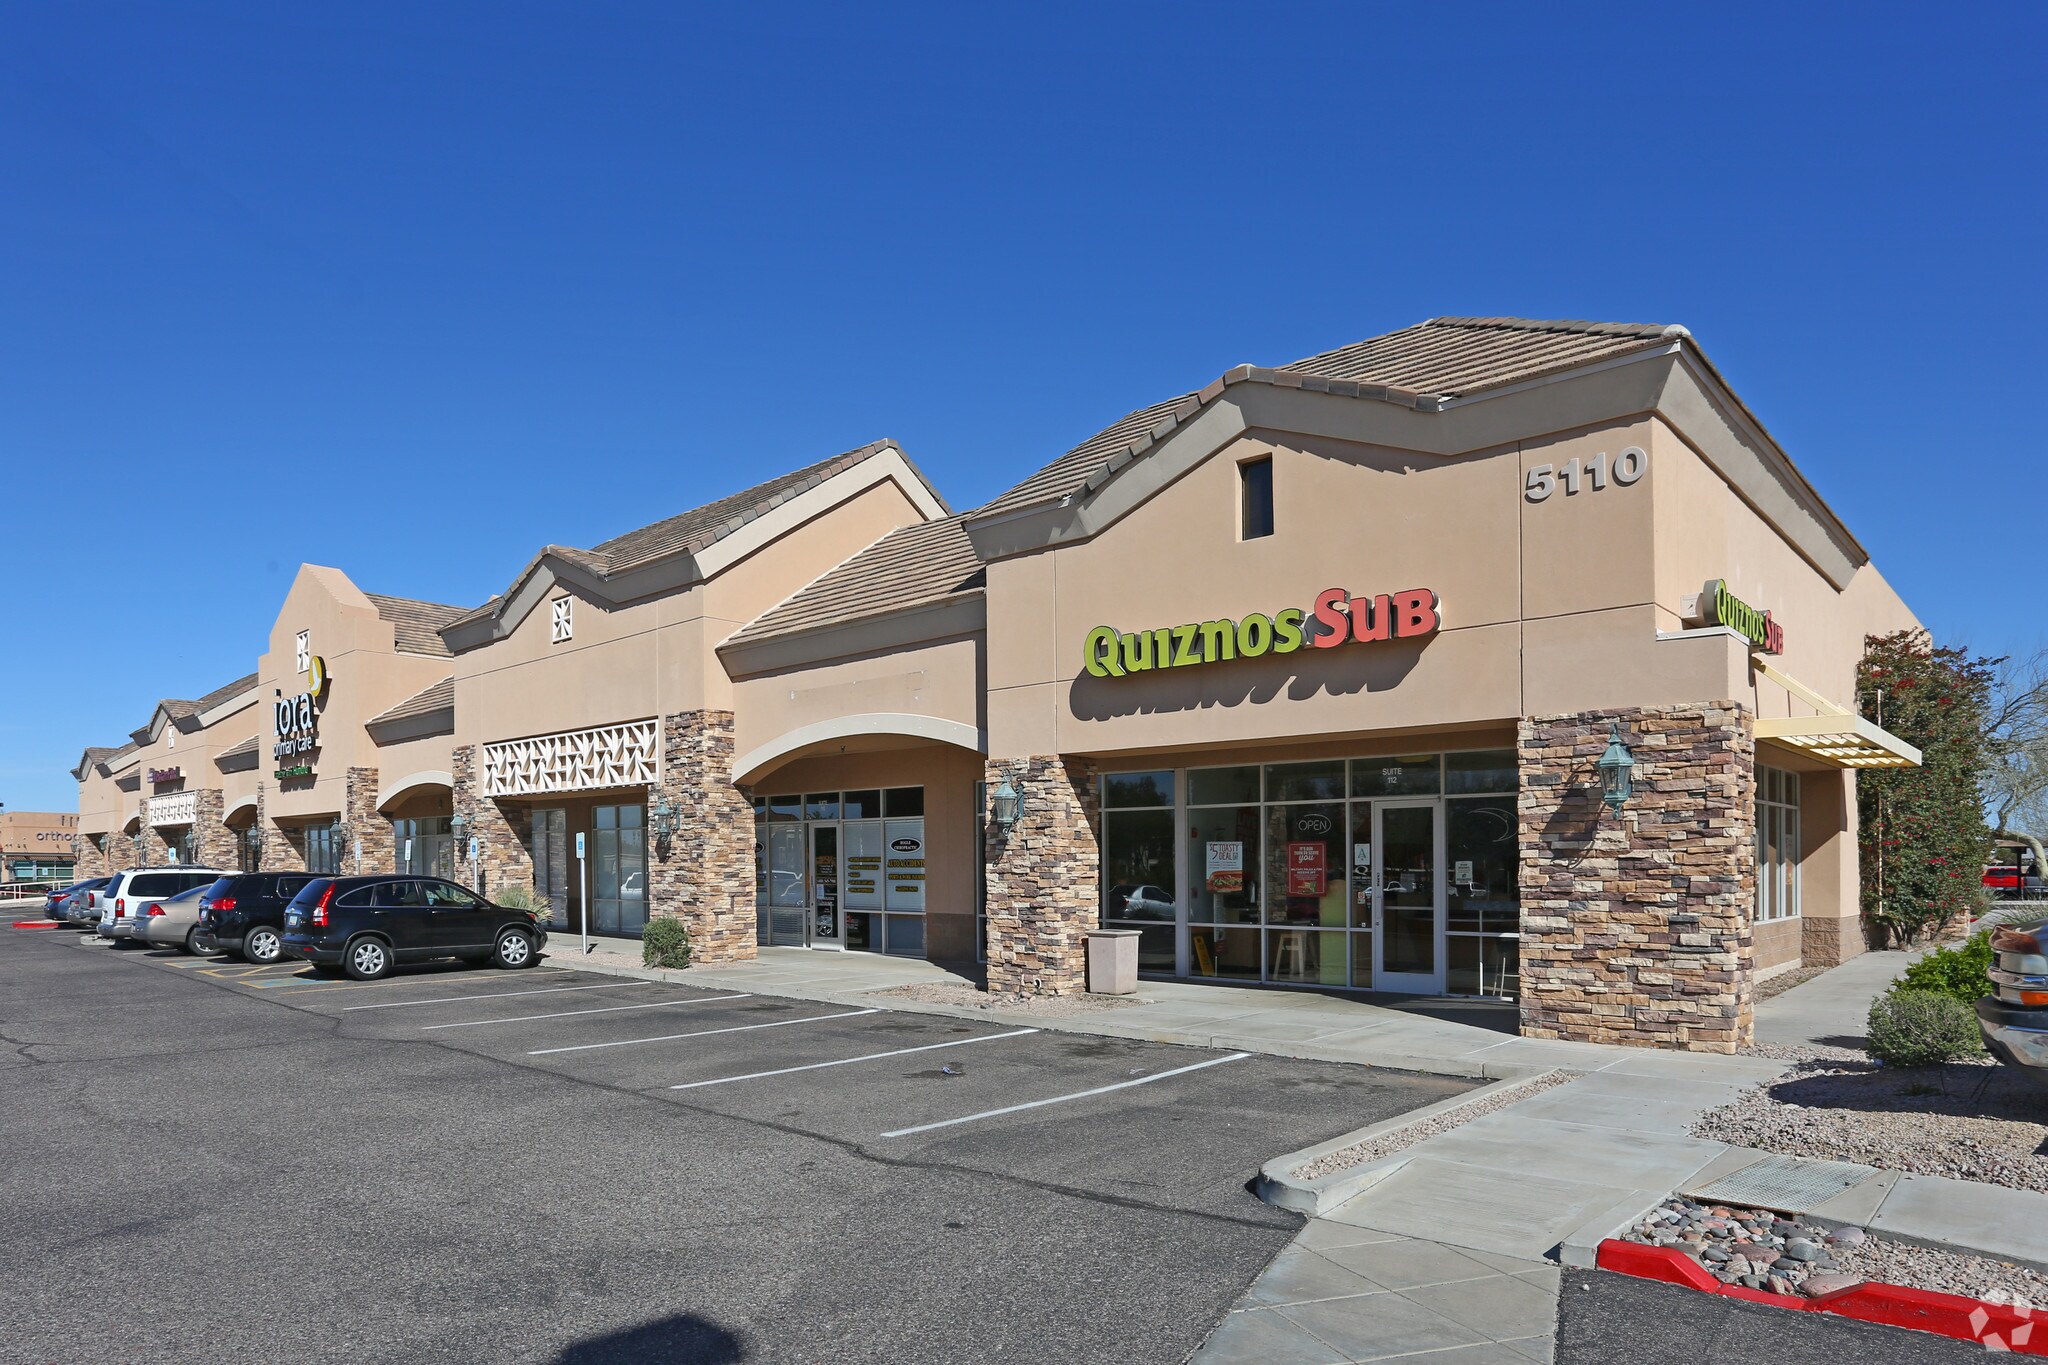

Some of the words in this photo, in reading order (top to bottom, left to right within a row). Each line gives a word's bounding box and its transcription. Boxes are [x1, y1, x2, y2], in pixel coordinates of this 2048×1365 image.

[1526, 446, 1648, 500] 5110
[1084, 608, 1304, 677] Quiznos
[273, 689, 313, 736] iora
[273, 739, 297, 758] primary
[298, 736, 313, 752] care
[1382, 767, 1402, 775] SUITE
[1387, 776, 1397, 784] 112
[1298, 819, 1327, 831] OPEN
[1209, 843, 1218, 860] $5
[1218, 843, 1239, 853] TOASTY
[1218, 851, 1232, 861] DEAL
[1358, 848, 1366, 858] A
[1298, 855, 1314, 864] you
[1354, 865, 1369, 876] Q
